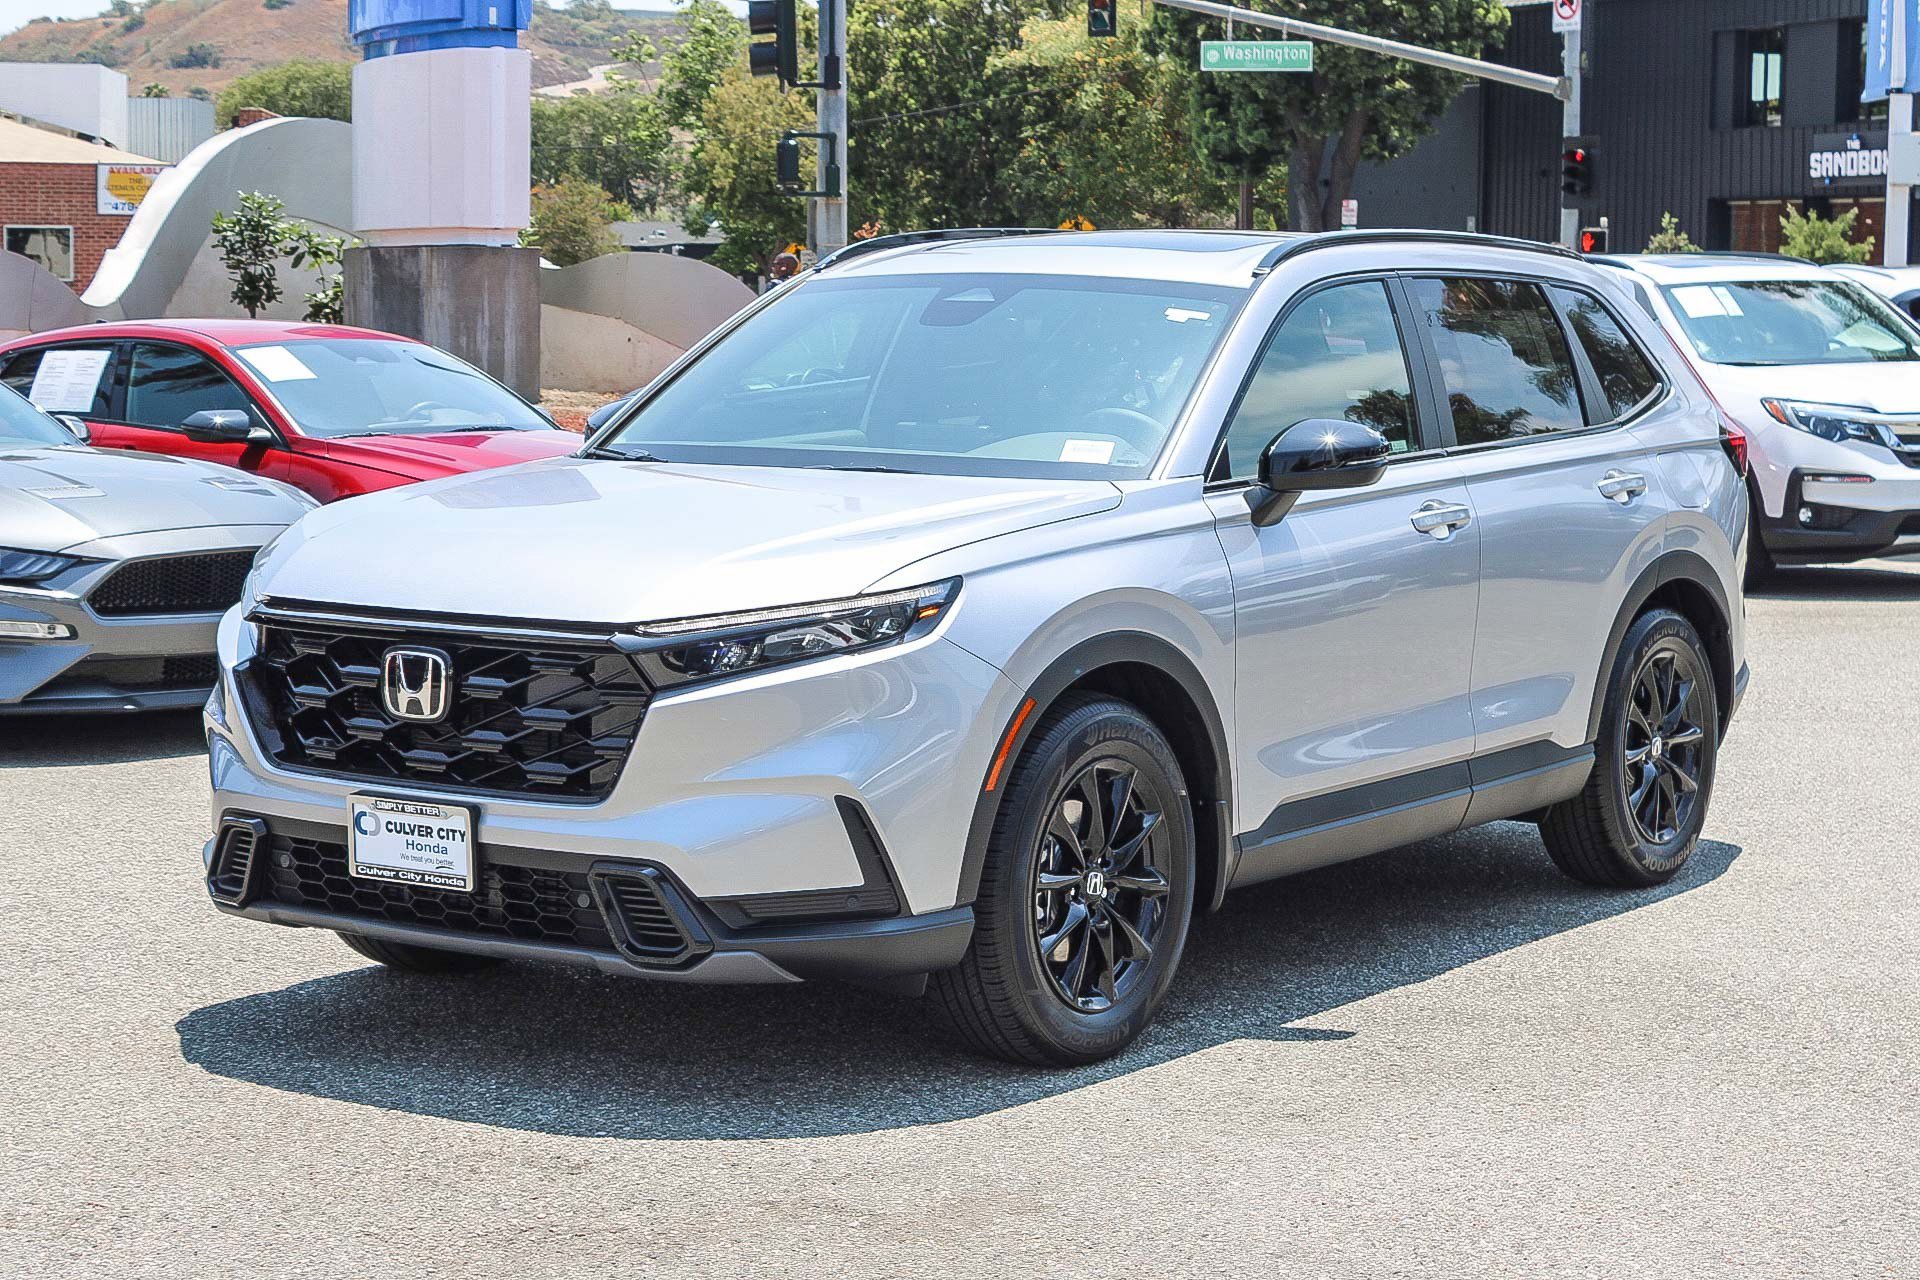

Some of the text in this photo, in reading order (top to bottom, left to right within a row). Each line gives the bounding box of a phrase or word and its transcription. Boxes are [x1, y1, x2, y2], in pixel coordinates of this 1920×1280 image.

[1223, 45, 1308, 64] Washington
[1846, 139, 1861, 150] THE
[376, 800, 440, 816] SIMPLY BETTER
[385, 820, 466, 842] CULVER CITY
[405, 839, 448, 855] Honda
[400, 853, 410, 861] We
[410, 854, 423, 862] treat
[423, 857, 435, 865] you
[357, 865, 465, 886] Culver City Honda
